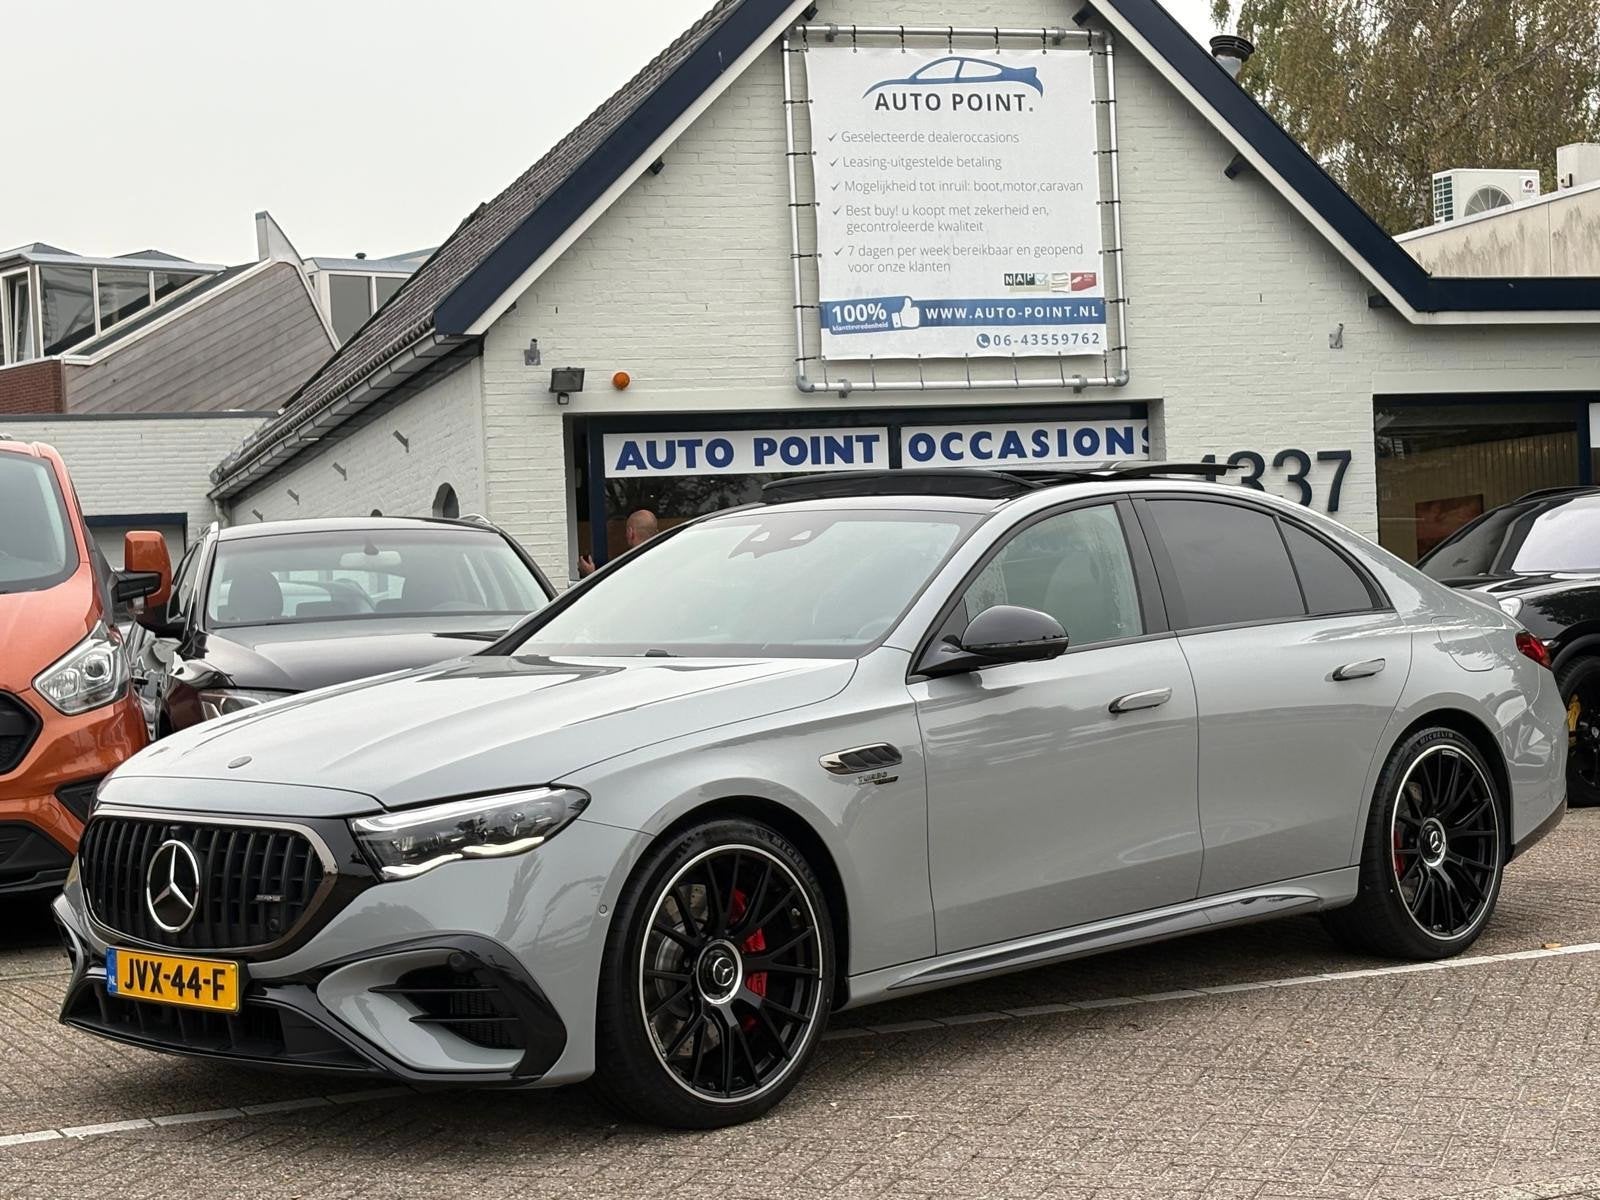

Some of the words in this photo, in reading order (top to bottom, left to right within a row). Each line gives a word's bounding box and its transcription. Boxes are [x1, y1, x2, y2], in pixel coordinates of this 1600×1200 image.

[874, 92, 942, 112] AUTO
[841, 130, 925, 143] Geselecteerde
[927, 130, 1020, 143] dealeroccasions
[842, 156, 954, 171] Leasing-uitgestelde
[956, 156, 1002, 171] betaling
[844, 180, 917, 195] Mogelijkheid
[919, 181, 936, 192] tot
[939, 180, 971, 192] inruil:
[973, 180, 1083, 193] boot,motor,caravan
[846, 204, 872, 216] Best
[874, 204, 899, 219] buy!
[902, 206, 910, 216] u
[912, 204, 946, 218] koopt
[948, 205, 971, 216] met
[974, 204, 1029, 216] zekerheid
[1032, 206, 1050, 217] en,
[846, 219, 935, 236] gecontroleerde
[937, 219, 984, 232] kwaliteit
[847, 245, 855, 257] 7
[857, 244, 895, 260] dagen
[897, 246, 917, 259] per
[919, 244, 950, 257] week
[952, 244, 1014, 257] bereikbaar
[1016, 246, 1031, 256] en
[1033, 244, 1084, 259] geopend
[847, 262, 875, 273] voor
[877, 262, 906, 273] onze
[908, 261, 951, 273] klanten
[1004, 273, 1035, 286] NAP
[831, 303, 887, 323] 100%
[925, 305, 1099, 319] WWW.AUTO-POINT.NL
[993, 332, 1100, 347] 06-43559762
[615, 437, 735, 471] AUTO
[752, 434, 881, 467] POINT
[124, 958, 226, 1002] JVX-44-F
